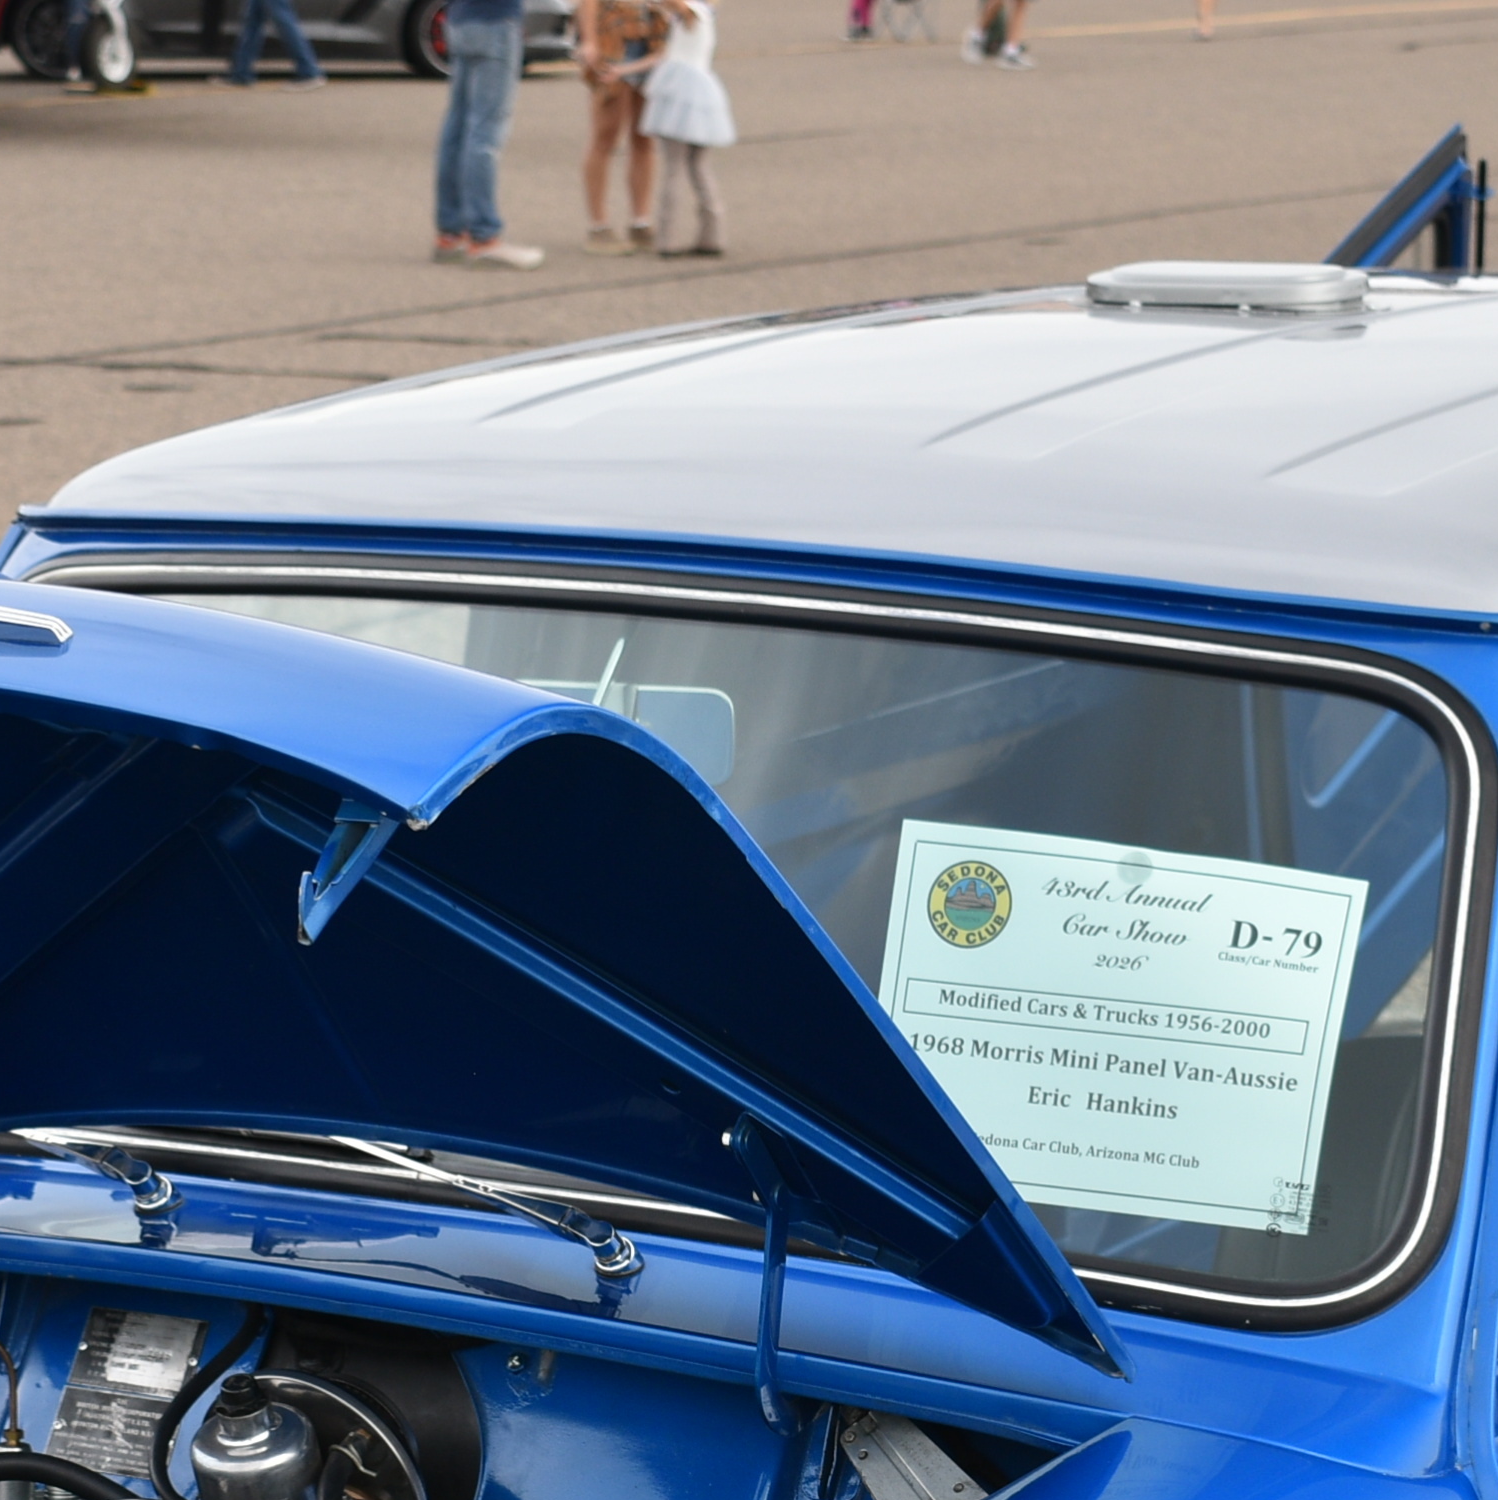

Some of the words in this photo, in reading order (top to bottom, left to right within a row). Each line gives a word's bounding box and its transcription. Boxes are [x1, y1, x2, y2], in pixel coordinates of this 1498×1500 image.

[937, 865, 1006, 896] SEDONA
[1042, 877, 1109, 901] 43rd
[1106, 884, 1213, 913] Annual
[932, 910, 959, 941] CAR
[965, 914, 1005, 944] CLUB
[1062, 913, 1110, 937] Car
[1115, 918, 1191, 946] Show
[1283, 927, 1323, 959] 79
[1093, 954, 1149, 971] 2026
[1217, 951, 1271, 967] Class/Car
[1272, 959, 1319, 974] Number
[938, 989, 1022, 1013] Modified
[1027, 998, 1069, 1018] Cars
[1072, 1003, 1088, 1020] &
[1093, 1004, 1159, 1027] Trucks
[1164, 1012, 1271, 1039] 1956-2000
[910, 1032, 965, 1056] 1968
[970, 1039, 1044, 1065] Morris
[1049, 1048, 1099, 1071] Mini
[1104, 1053, 1167, 1078] Panel
[1172, 1060, 1299, 1092] Van-Aussie
[1027, 1085, 1072, 1108] Eric
[1086, 1092, 1179, 1120] Hankins
[976, 1132, 1019, 1149] edona
[1021, 1137, 1047, 1152] Car
[1048, 1140, 1084, 1157] Club,
[1086, 1145, 1141, 1163] Arizona
[1142, 1151, 1166, 1165] MG
[1168, 1154, 1201, 1169] Club
